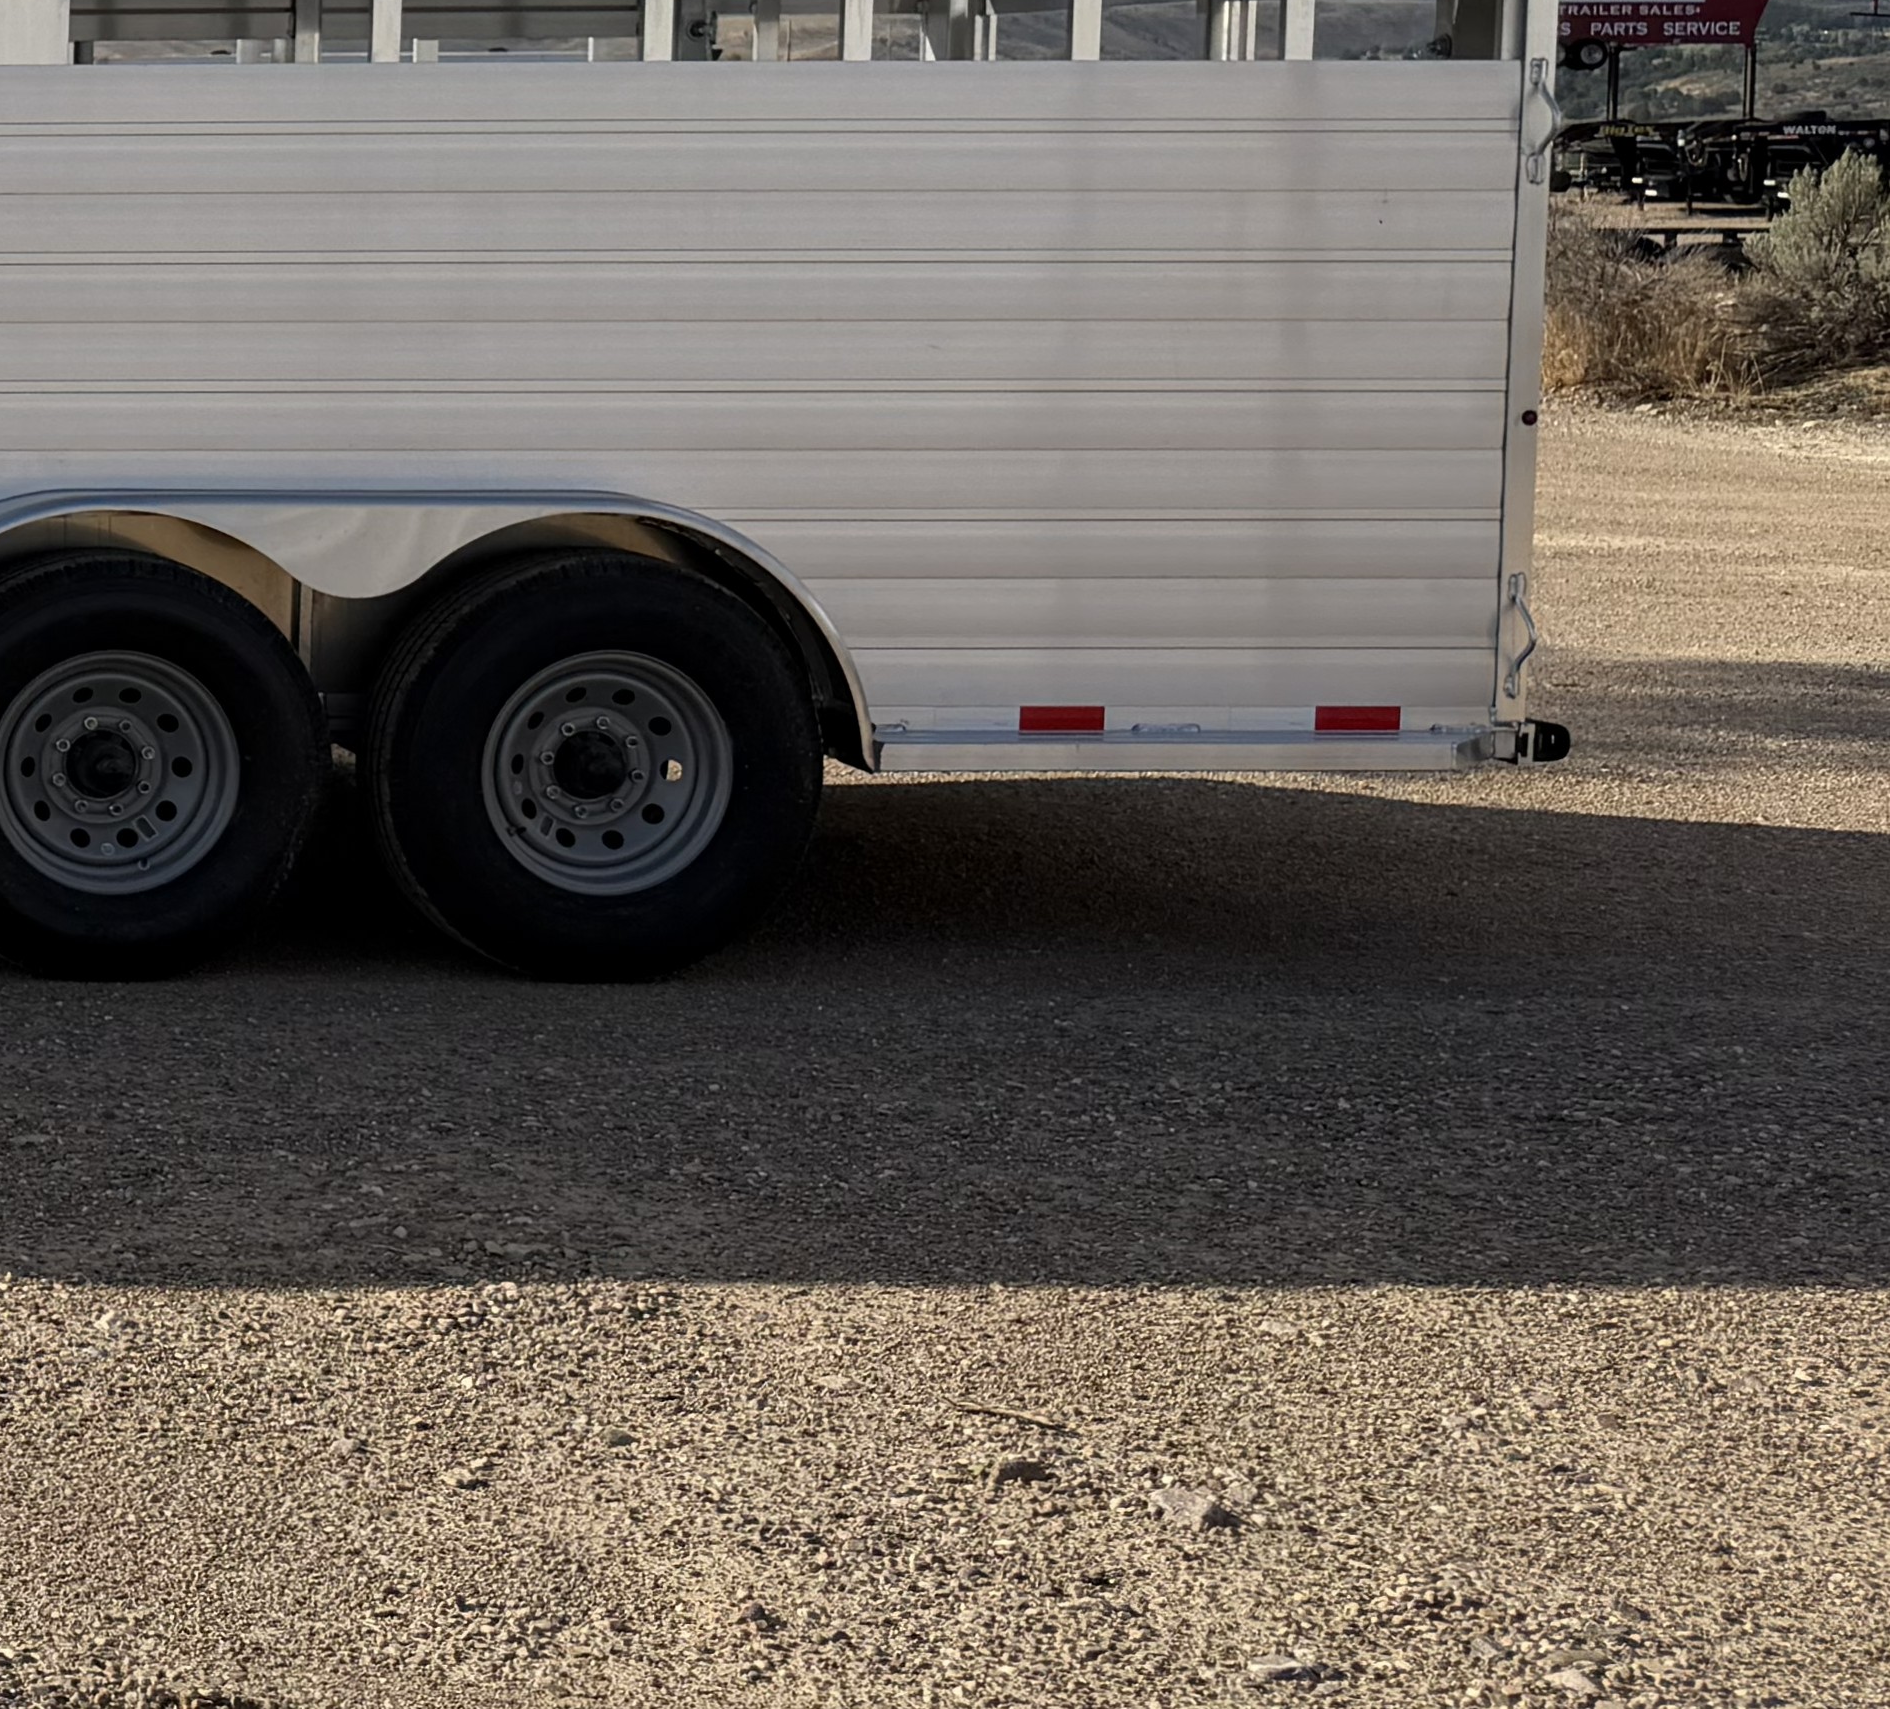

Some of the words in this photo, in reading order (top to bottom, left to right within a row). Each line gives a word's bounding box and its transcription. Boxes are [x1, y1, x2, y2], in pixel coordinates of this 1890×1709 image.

[1560, 4, 1632, 15] TRAILER
[1590, 21, 1648, 36] PARTS
[1663, 21, 1741, 36] SERVICE
[1783, 124, 1837, 135] WALTON
